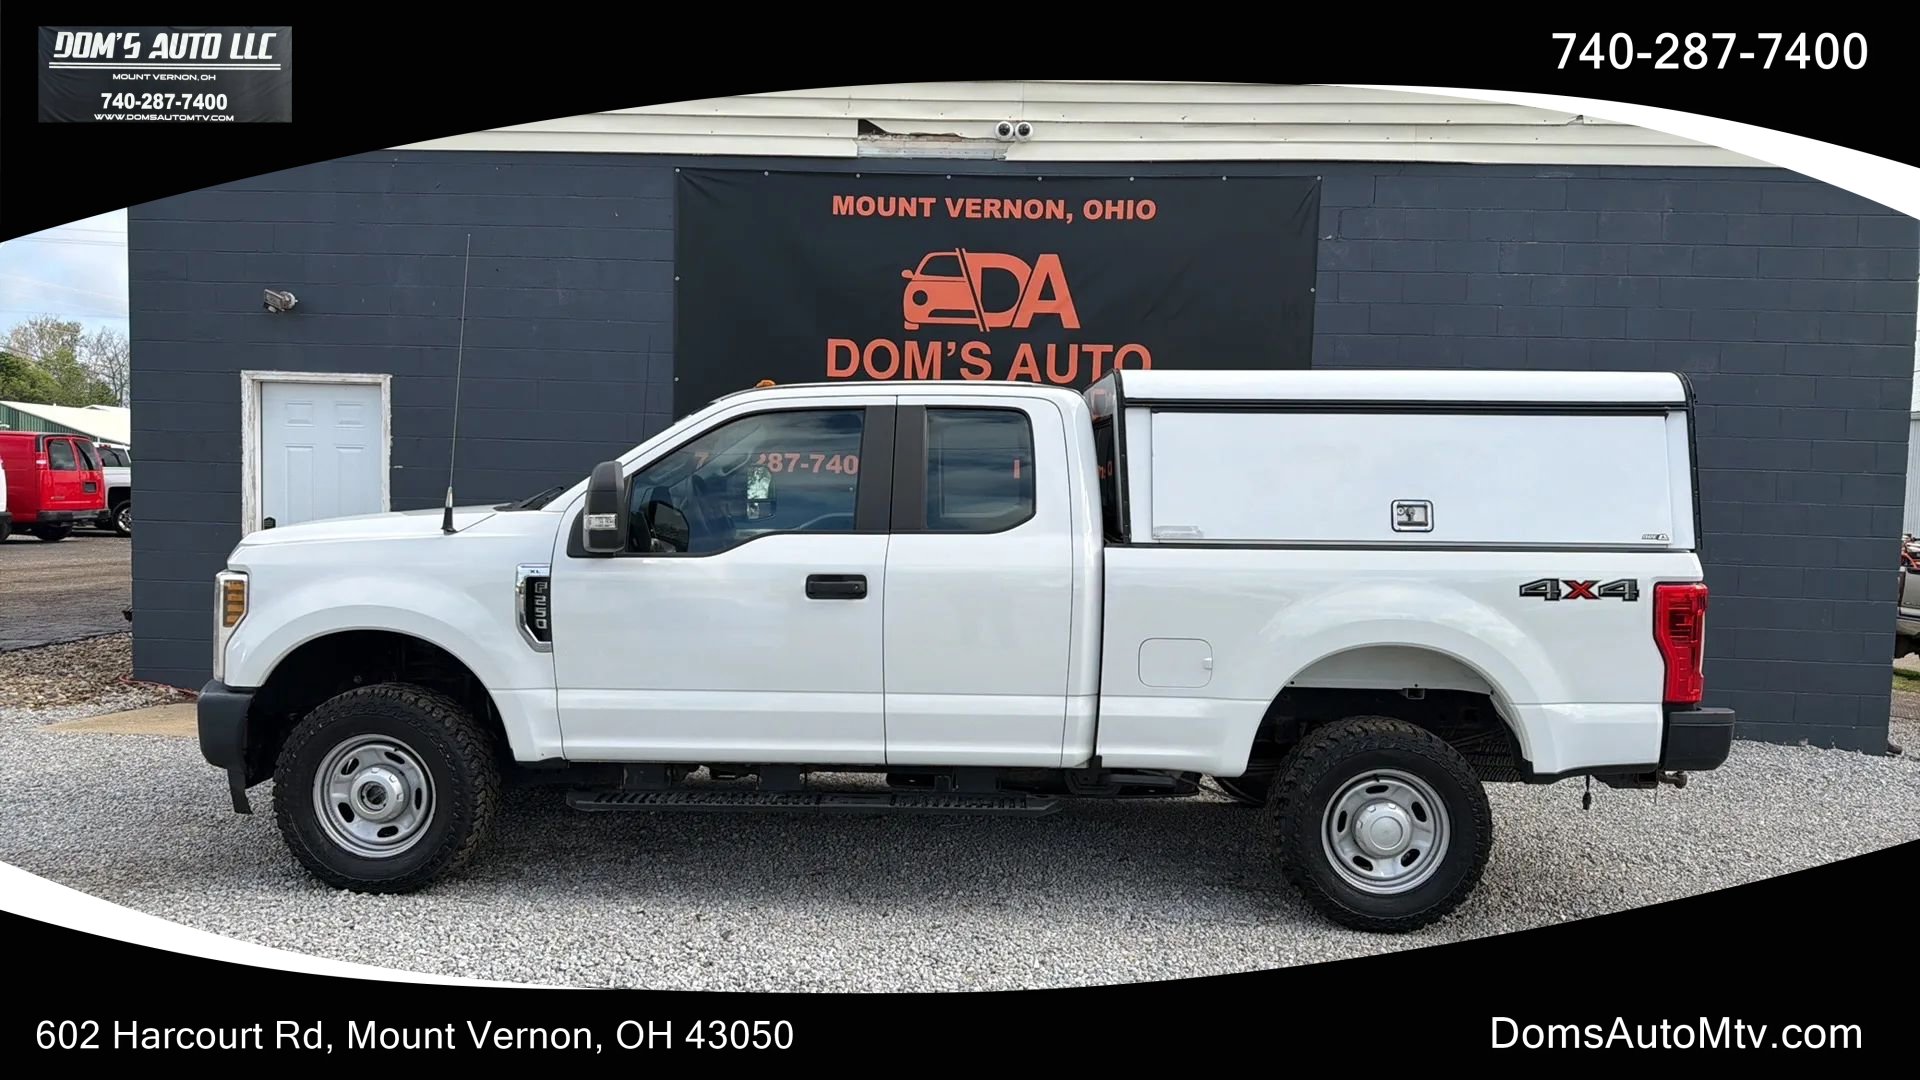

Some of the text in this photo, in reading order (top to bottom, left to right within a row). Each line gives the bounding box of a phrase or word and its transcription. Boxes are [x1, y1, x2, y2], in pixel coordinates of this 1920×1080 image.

[832, 195, 1157, 224] MOUNT VERNON, OHIO
[826, 338, 1152, 384] DOM'S AUTO
